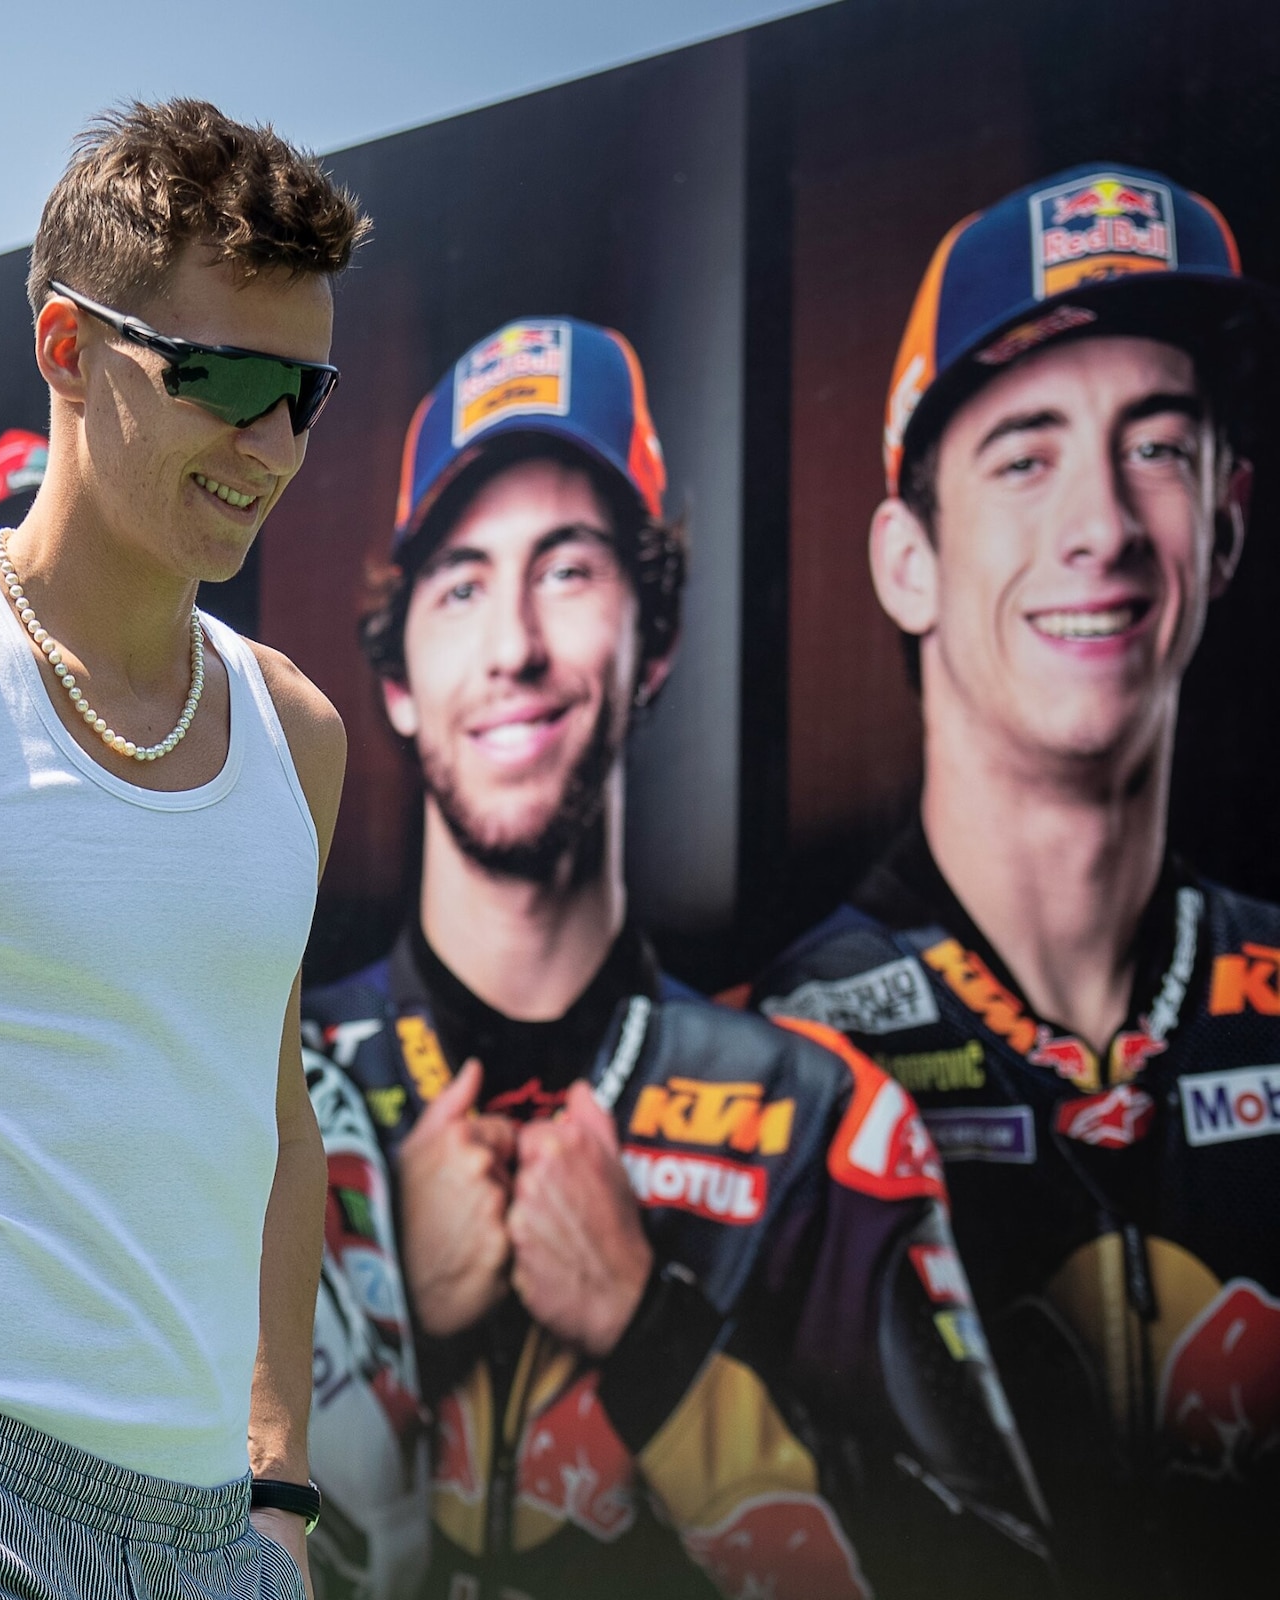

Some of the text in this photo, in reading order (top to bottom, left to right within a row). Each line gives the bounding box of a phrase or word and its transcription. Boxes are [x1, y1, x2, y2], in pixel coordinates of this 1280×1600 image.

[1042, 216, 1169, 265] Red Bull
[628, 1075, 796, 1157] KTM
